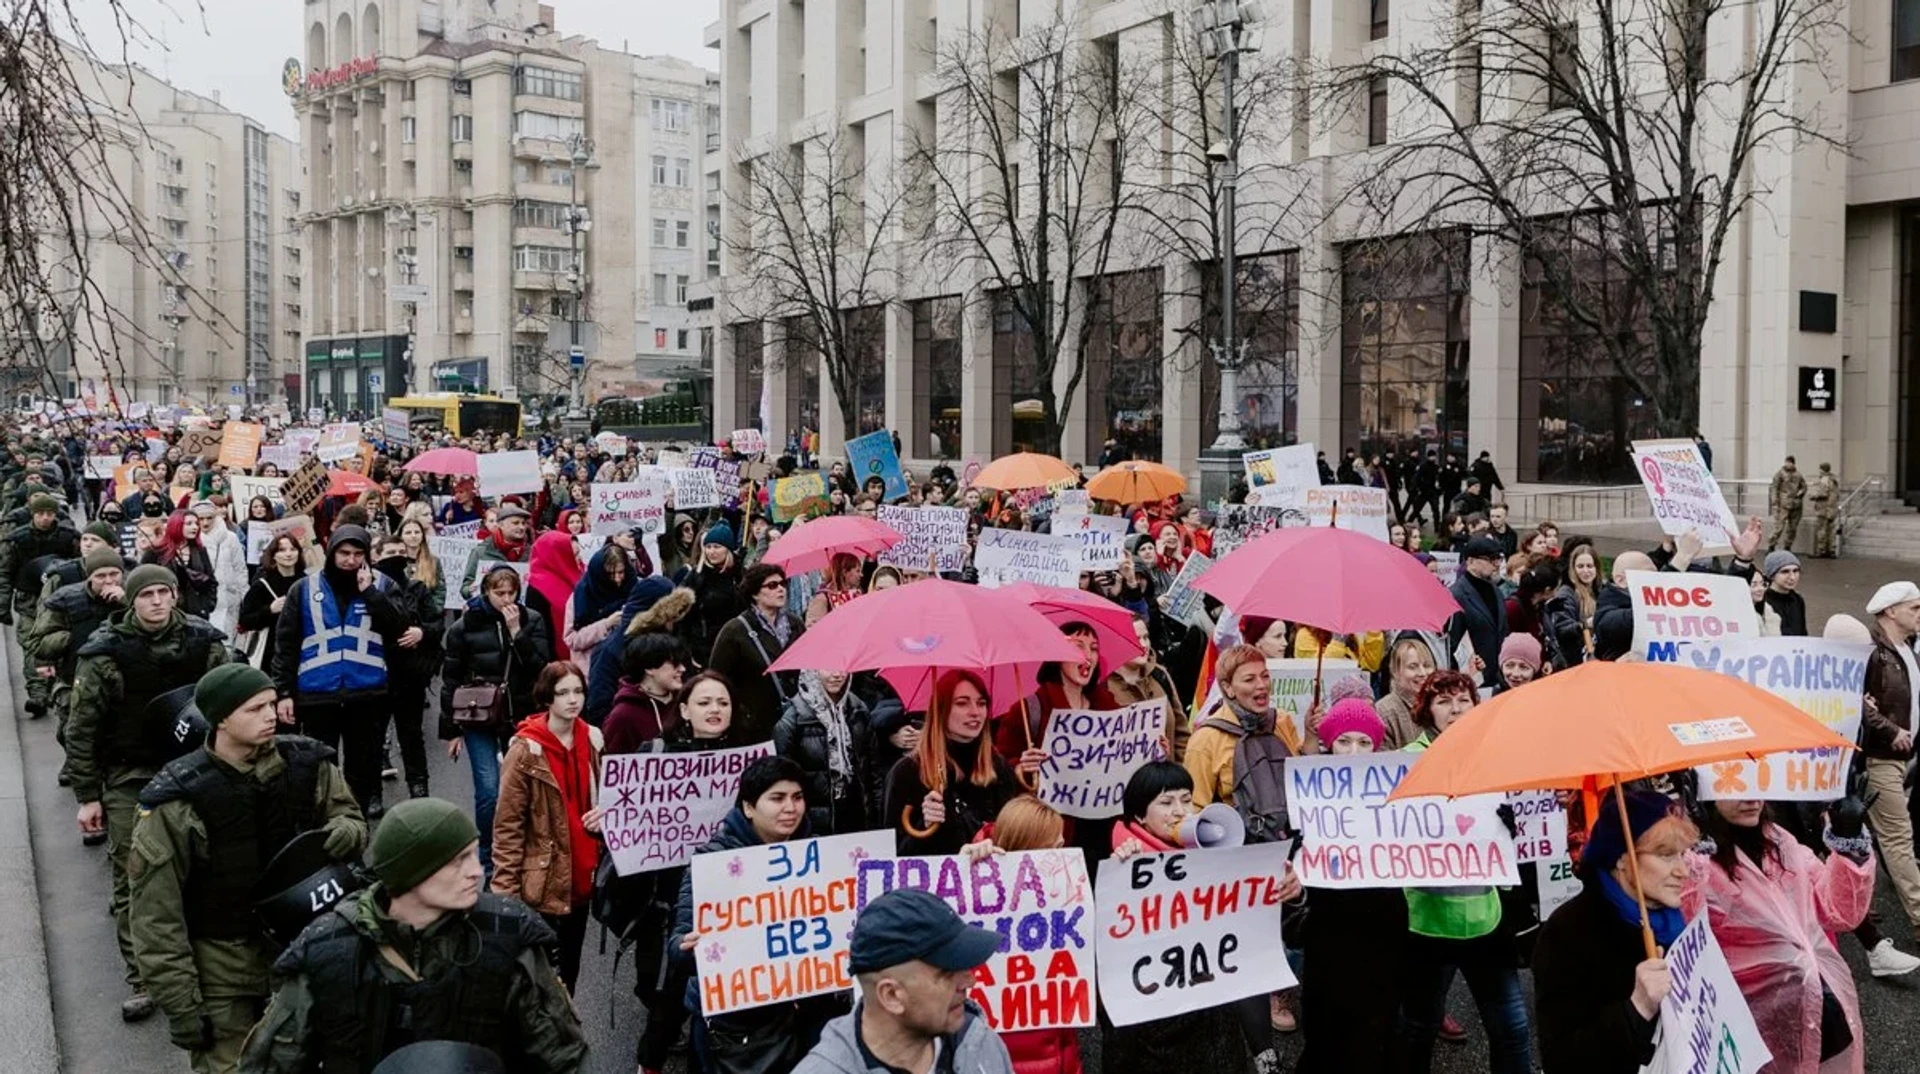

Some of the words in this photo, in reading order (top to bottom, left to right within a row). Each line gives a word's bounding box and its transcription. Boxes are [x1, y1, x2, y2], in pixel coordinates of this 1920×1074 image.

[600, 491, 607, 503] Я
[615, 489, 652, 501] СИЛЬНА
[1081, 517, 1091, 530] Я
[1641, 586, 1713, 608] МОЄ
[1691, 646, 1865, 694] УКРАЇНСЬКА
[174, 719, 191, 743] 127
[1052, 703, 1162, 738] КОХАЙТЕ
[1293, 765, 1353, 801] МОЯ
[1712, 747, 1850, 794] ЖІНКА!
[614, 780, 702, 808] ЖІНКА
[708, 776, 741, 800] МА
[1049, 779, 1126, 808] ЖІНО
[603, 805, 691, 831] ПРАВО
[1298, 805, 1359, 839] МОЄ
[1365, 802, 1445, 840] ТІЛО
[765, 839, 821, 883] ЗА
[1300, 844, 1365, 882] МОЯ
[1369, 841, 1507, 881] СВОБОДА
[309, 878, 345, 912] 127
[856, 853, 1046, 916] ПРАВА
[697, 876, 858, 935] СУСПІЛЬСТ
[1108, 875, 1280, 940] ЗНАЧИТЬ
[702, 949, 853, 1012] НАСИЛЬС
